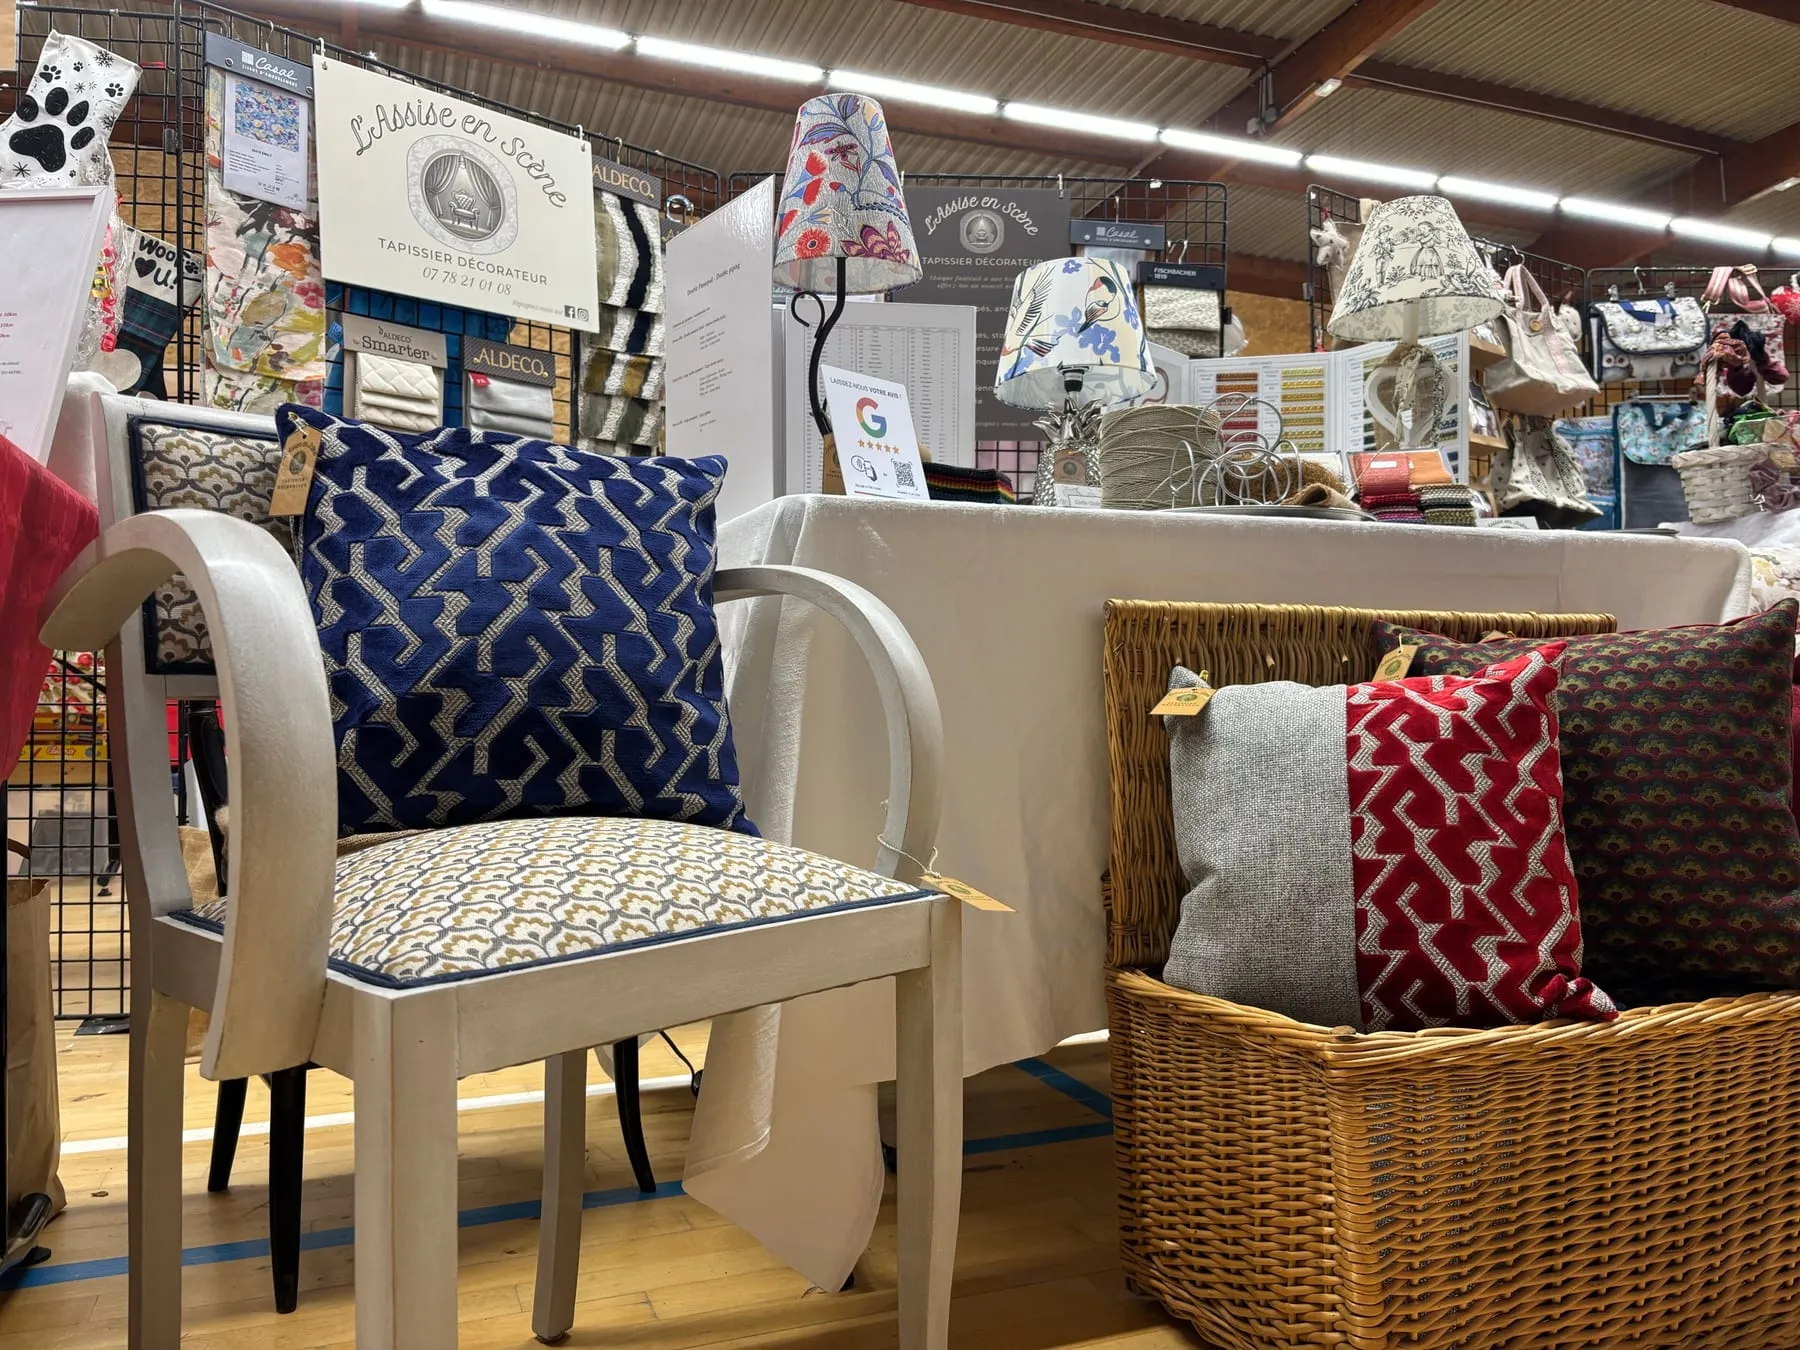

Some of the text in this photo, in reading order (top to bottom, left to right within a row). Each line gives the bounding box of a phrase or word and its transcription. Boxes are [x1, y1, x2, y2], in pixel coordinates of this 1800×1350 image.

[255, 57, 298, 80] Casal
[350, 99, 567, 208] L'Assise en Scène
[592, 164, 652, 197] ALDECO
[924, 196, 1039, 236] L'Assise en Scène
[1106, 226, 1139, 239] Casal
[378, 237, 549, 286] TAPISSIER DÉCORATEUR
[921, 256, 973, 266] TAPISSIER
[1153, 267, 1197, 277] FISCHBACHER
[422, 266, 512, 296] 07 78 21 01 08
[361, 335, 430, 361] Smarter
[383, 332, 412, 343] ALDECO
[475, 347, 545, 375] ALDECO
